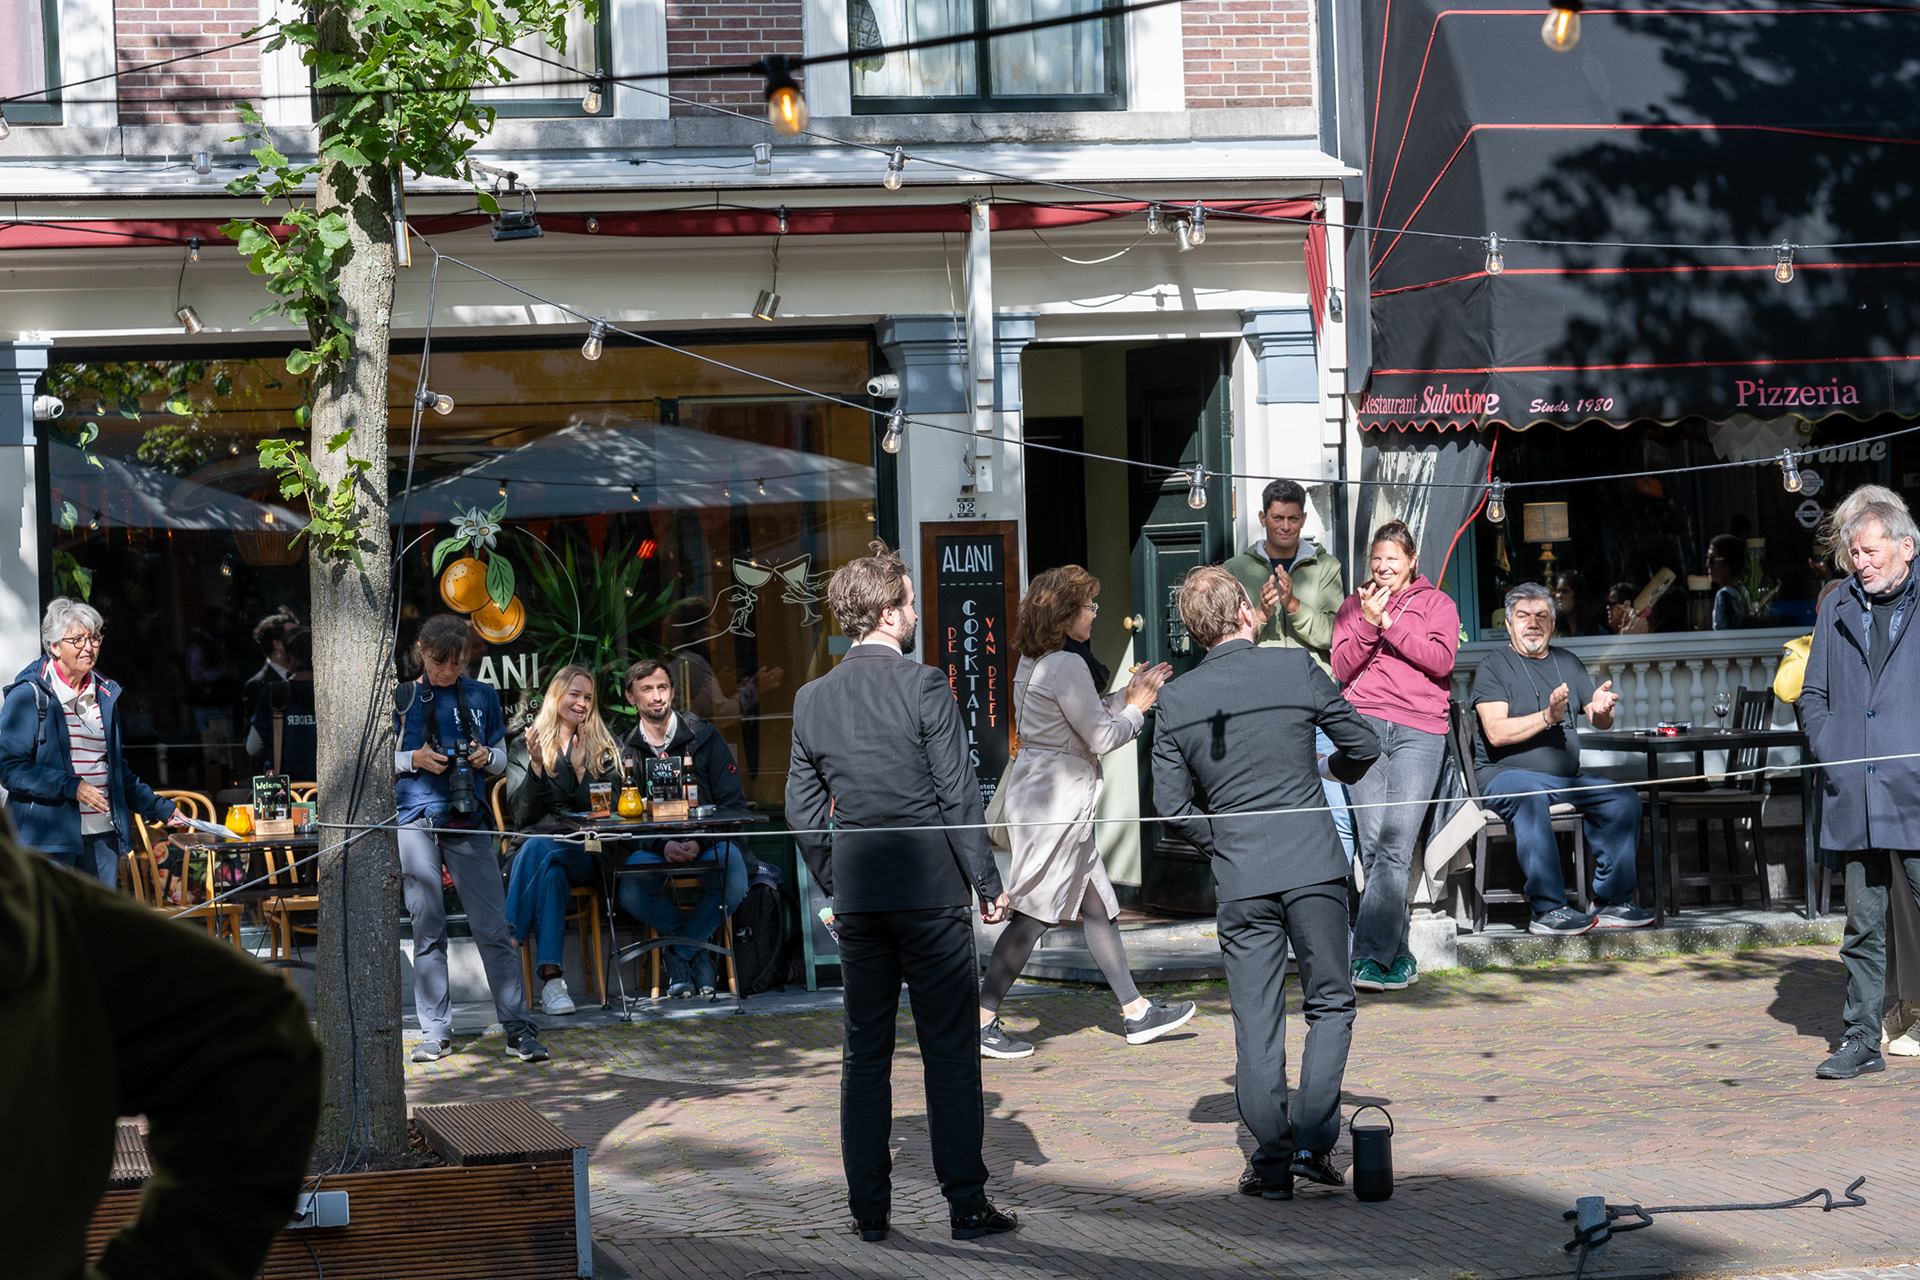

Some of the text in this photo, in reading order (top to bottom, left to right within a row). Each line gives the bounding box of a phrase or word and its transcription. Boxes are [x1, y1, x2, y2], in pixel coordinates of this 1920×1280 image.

[1360, 383, 1500, 415] Restaurant Salvatore
[1529, 397, 1614, 413] Sinds 1980
[1735, 377, 1860, 407] Pizzeria
[958, 502, 975, 513] 92
[942, 545, 993, 573] ALANI
[477, 653, 540, 690] ANI
[962, 599, 981, 768] COCKTAILS
[985, 617, 997, 728] VAN DELFT
